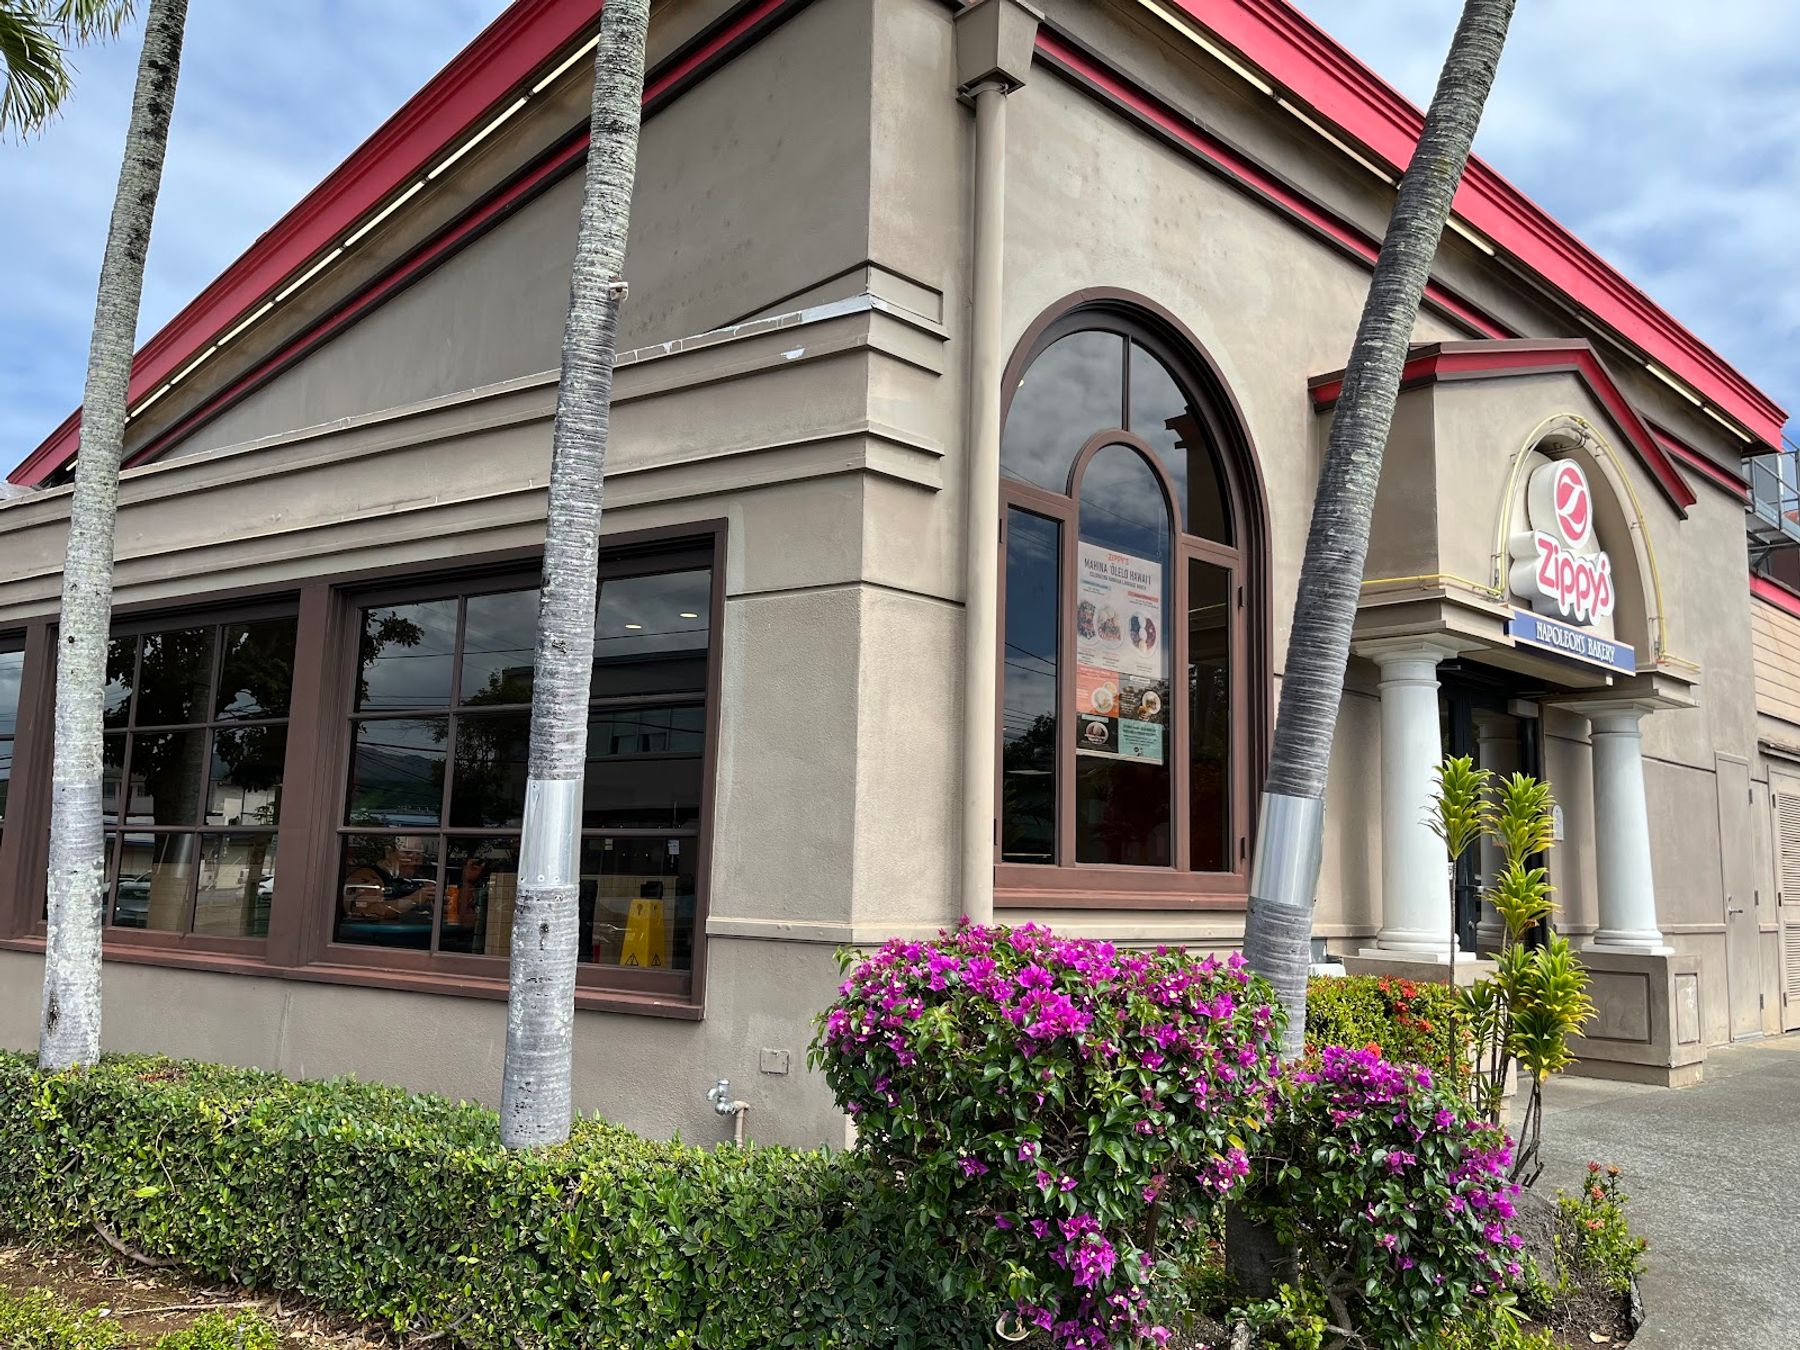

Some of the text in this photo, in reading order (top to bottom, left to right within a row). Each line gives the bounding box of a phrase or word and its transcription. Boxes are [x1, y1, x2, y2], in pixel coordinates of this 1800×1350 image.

[1084, 558, 1108, 573] MAHINA
[1538, 538, 1609, 616] Zippy's
[1536, 621, 1616, 664] NAPOLEON'S BAKERY
